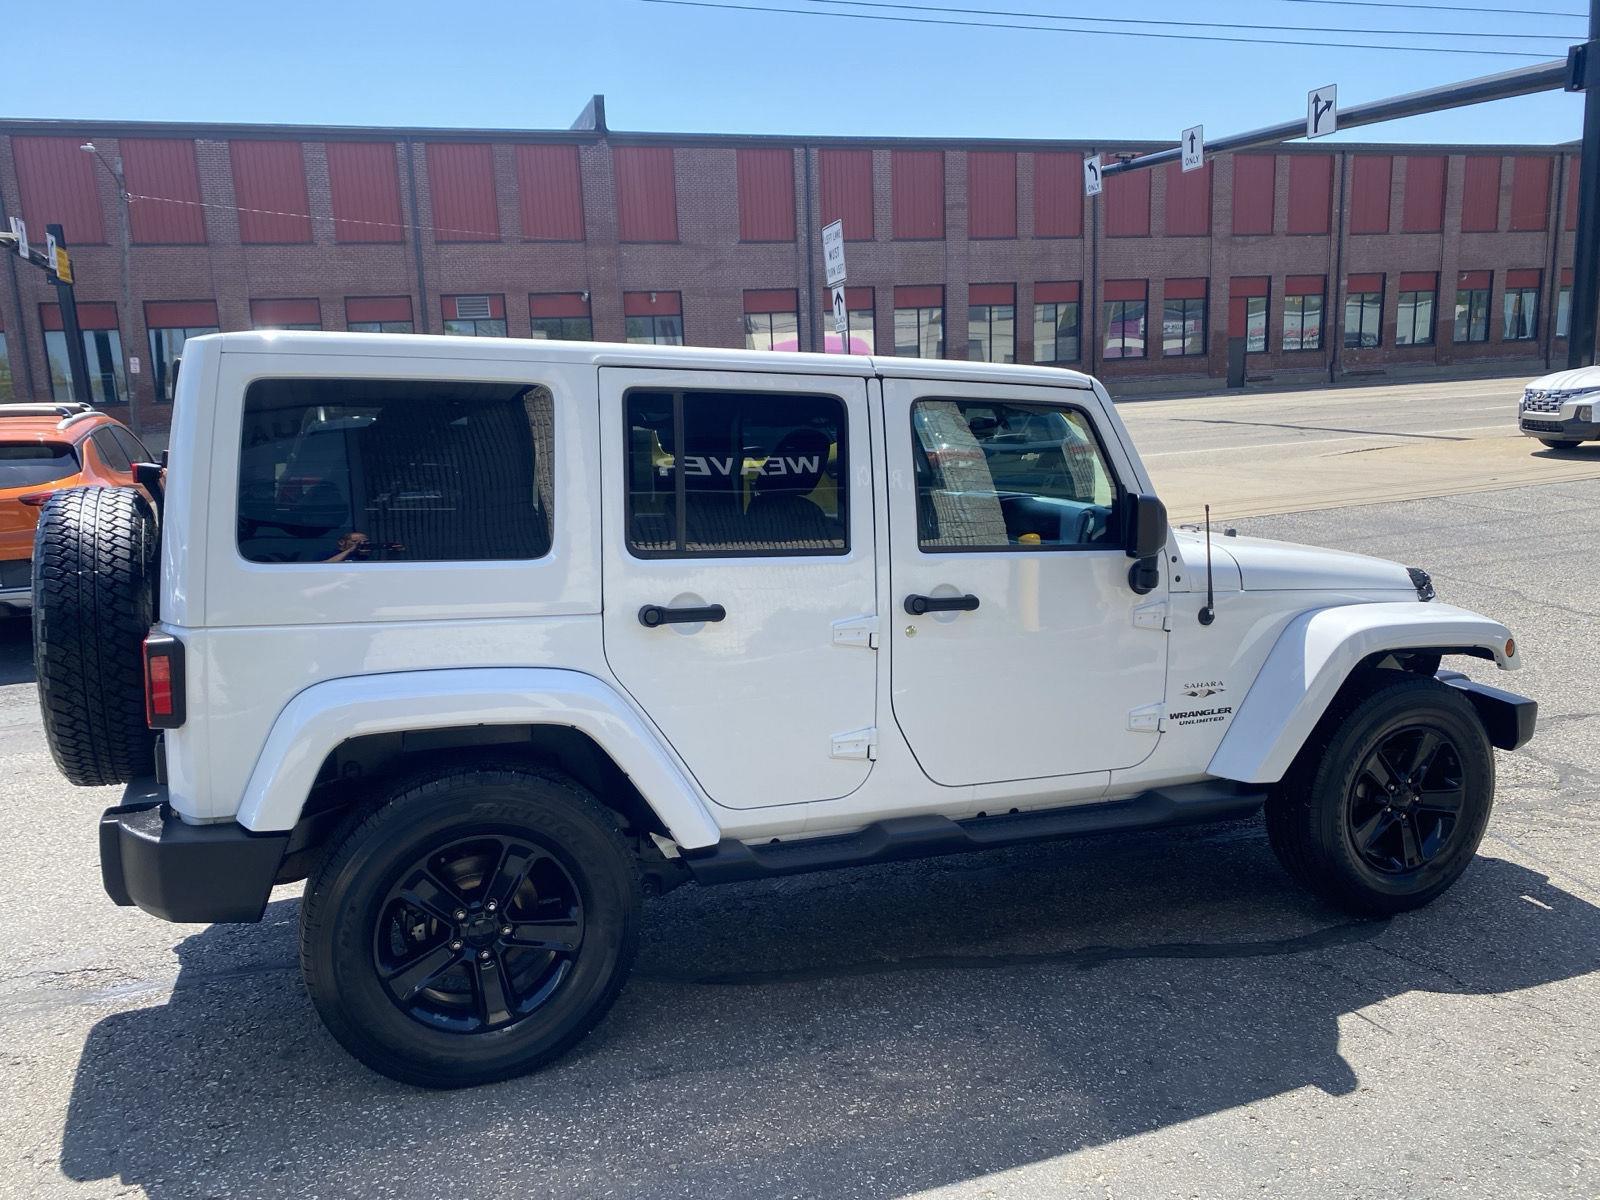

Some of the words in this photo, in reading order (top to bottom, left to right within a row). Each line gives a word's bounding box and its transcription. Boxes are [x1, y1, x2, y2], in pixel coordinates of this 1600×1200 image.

[1185, 155, 1200, 166] ONLY
[1088, 183, 1100, 192] ONLY
[829, 247, 840, 261] MUST
[1184, 681, 1224, 689] SAHARA
[1169, 707, 1232, 719] WRANGLER
[1179, 717, 1225, 726] UNLIMITED
